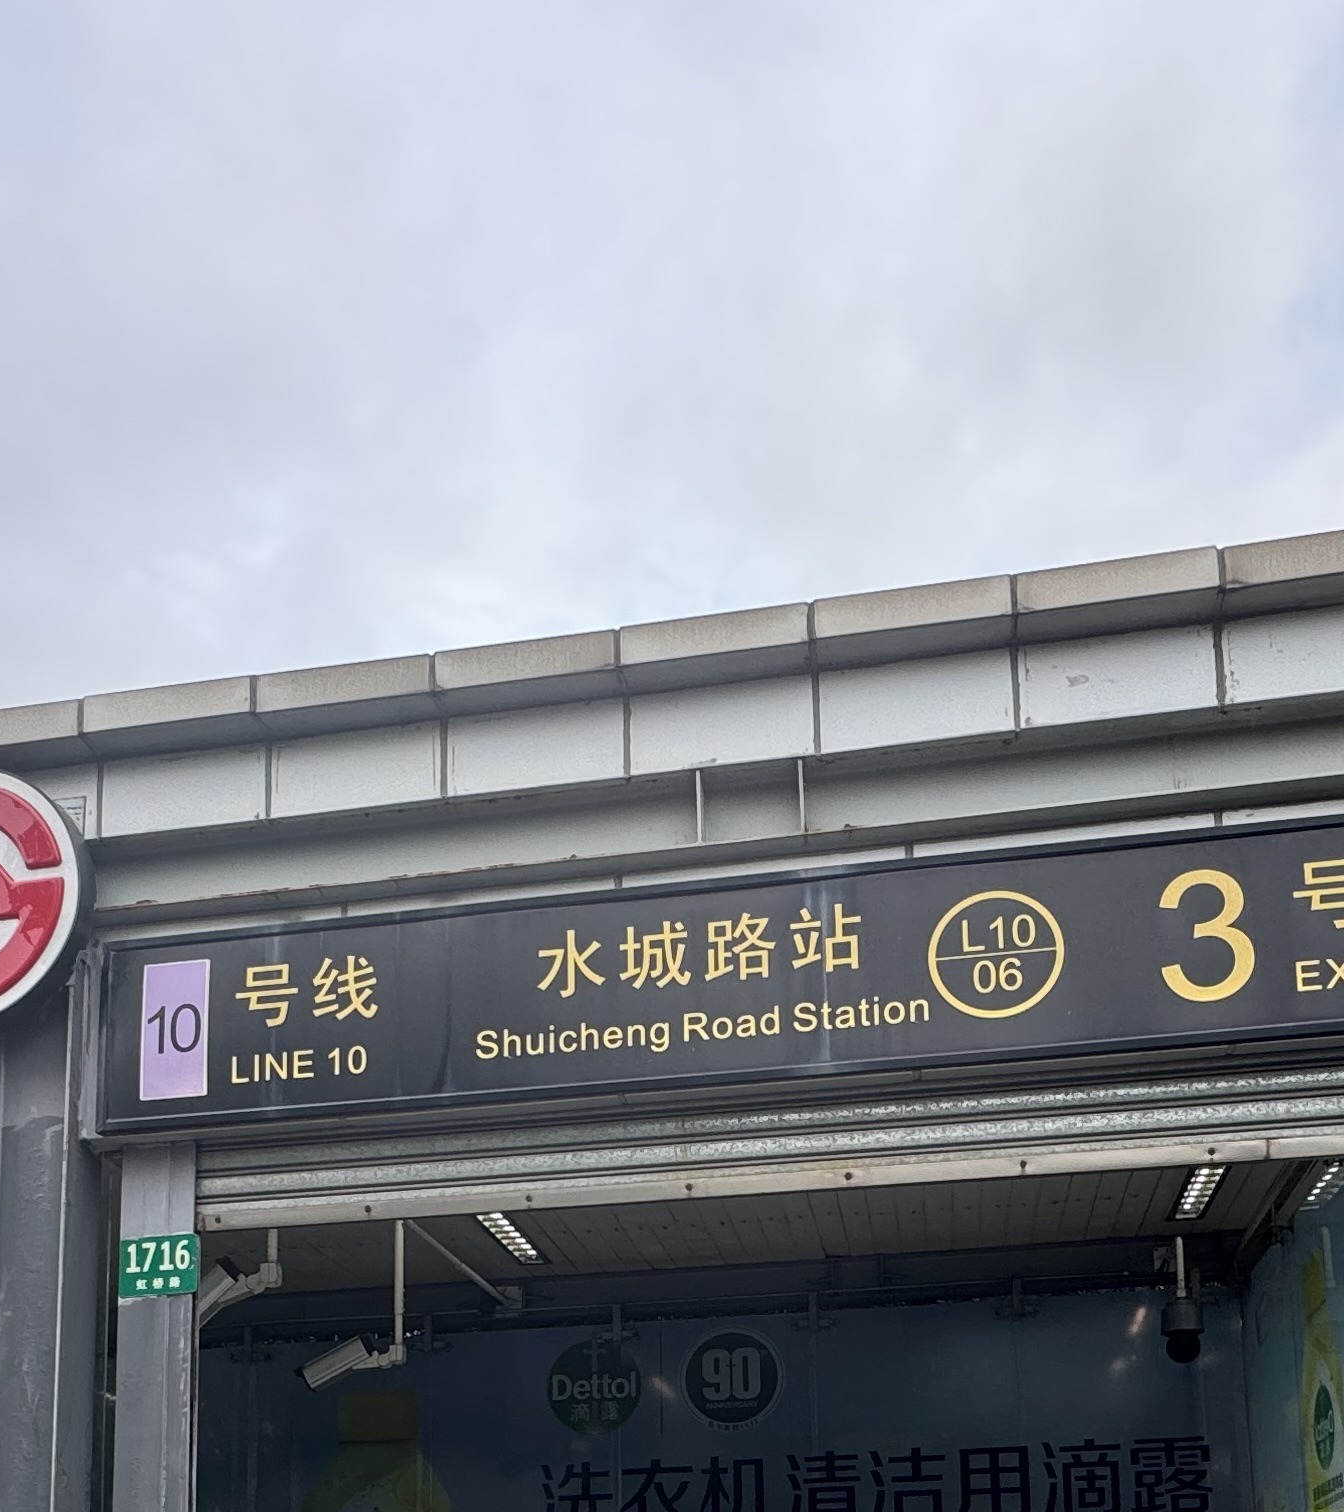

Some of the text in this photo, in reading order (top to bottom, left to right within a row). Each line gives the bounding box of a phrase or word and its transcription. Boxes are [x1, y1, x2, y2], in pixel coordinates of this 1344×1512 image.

[537, 903, 862, 998] 水城路站
[960, 912, 1037, 955] L10
[1159, 868, 1256, 1003] 3
[972, 957, 1023, 994] 06
[146, 955, 379, 1055] 10 号线
[475, 996, 931, 1060] Shuicheng Road Station
[231, 1045, 368, 1085] LINE 10
[125, 1240, 190, 1273] 1716
[551, 1370, 638, 1400] Dettol
[702, 1347, 761, 1401] 90
[571, 1402, 620, 1422] 滴露
